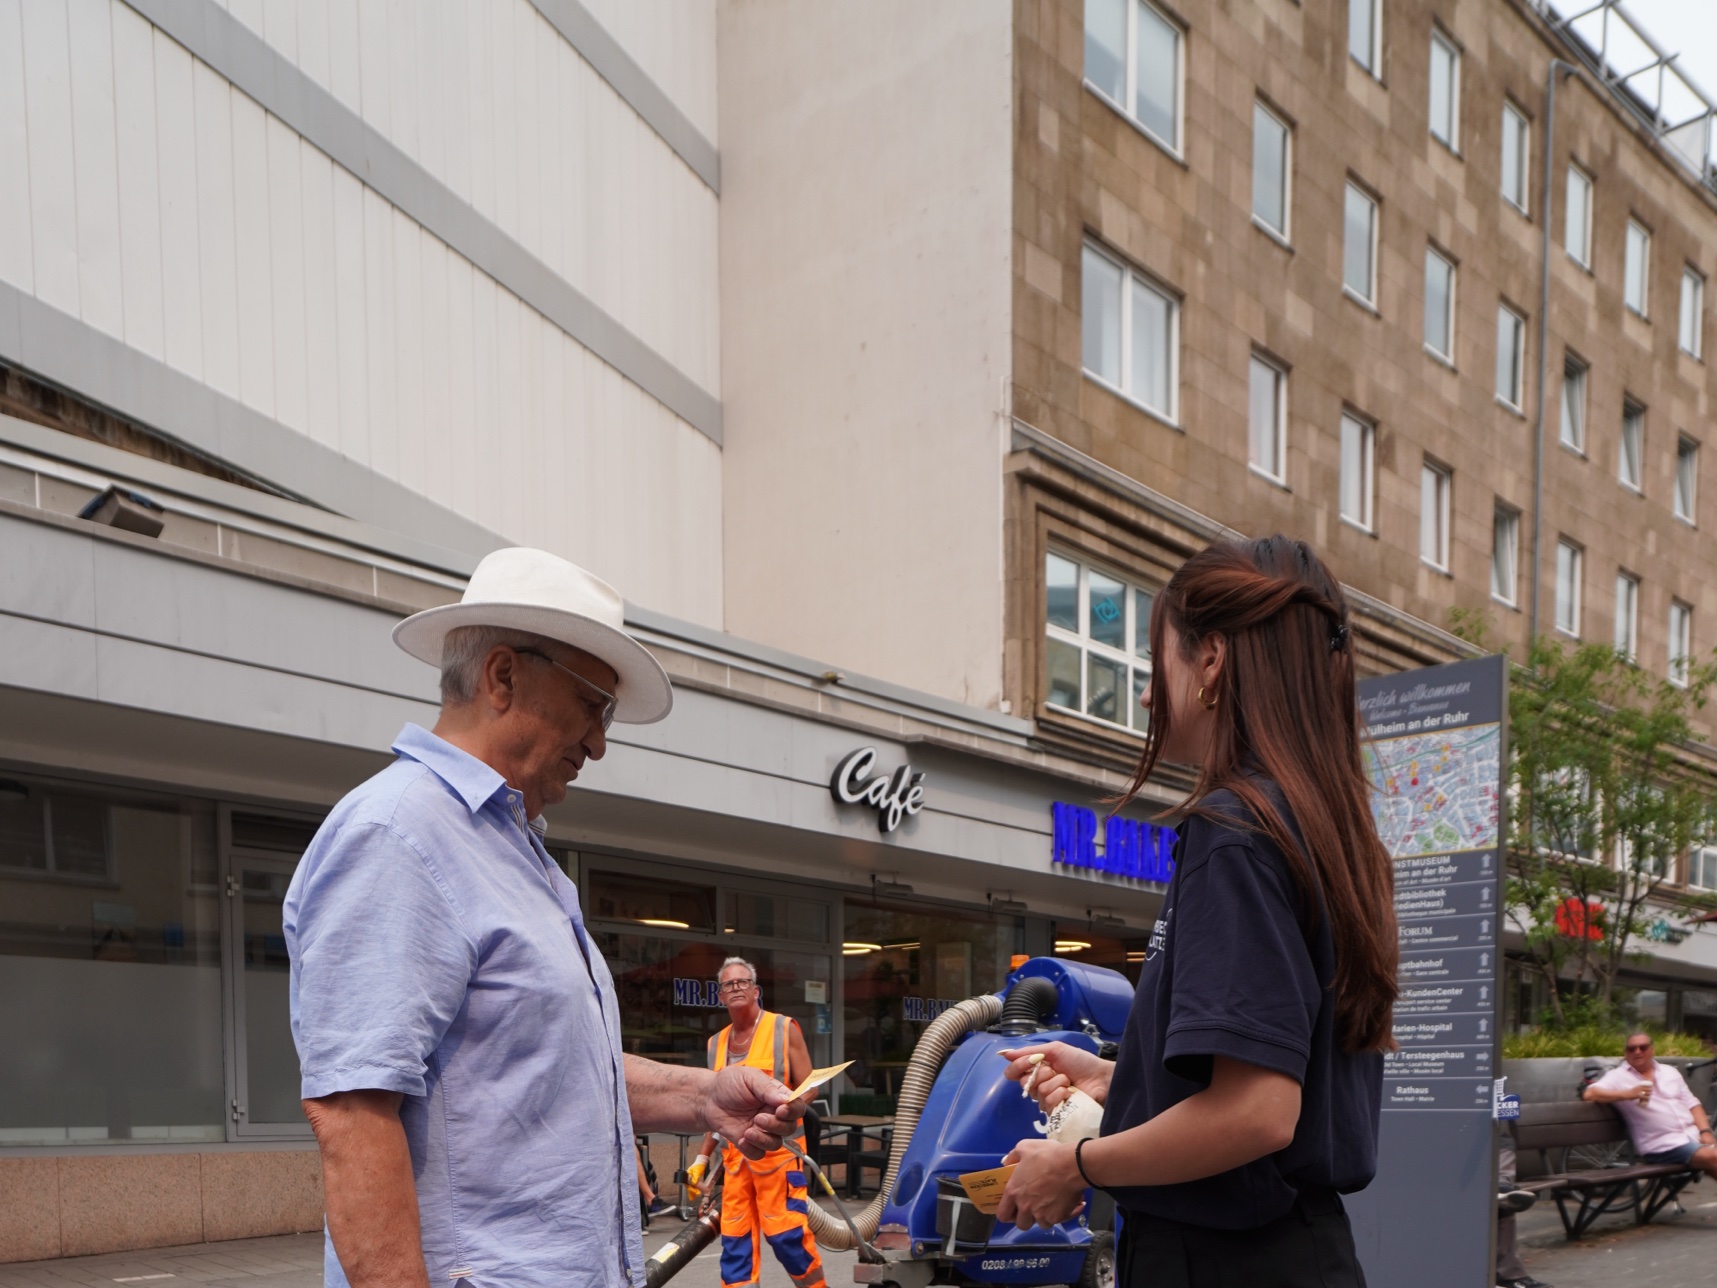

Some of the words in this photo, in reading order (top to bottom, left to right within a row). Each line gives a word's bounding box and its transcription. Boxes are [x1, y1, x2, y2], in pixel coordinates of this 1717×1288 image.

[1400, 681, 1471, 703] willkommen
[1408, 720, 1421, 730] an
[1423, 715, 1441, 727] der
[1444, 711, 1470, 724] Ruhr
[832, 746, 926, 832] Café
[1394, 855, 1451, 868] NSTMUSEUM
[1411, 869, 1421, 877] an
[1423, 867, 1437, 875] der
[1438, 865, 1458, 874] Ruhr
[1394, 888, 1447, 900] dtbibliothek
[1394, 898, 1444, 909] edienHaus)
[1397, 958, 1444, 971] uptbahnhof
[1400, 1051, 1465, 1060] Tersteegenhaus
[1396, 1086, 1429, 1094] Rathaus
[1497, 1101, 1519, 1109] CKER
[981, 1260, 1006, 1270] 0208
